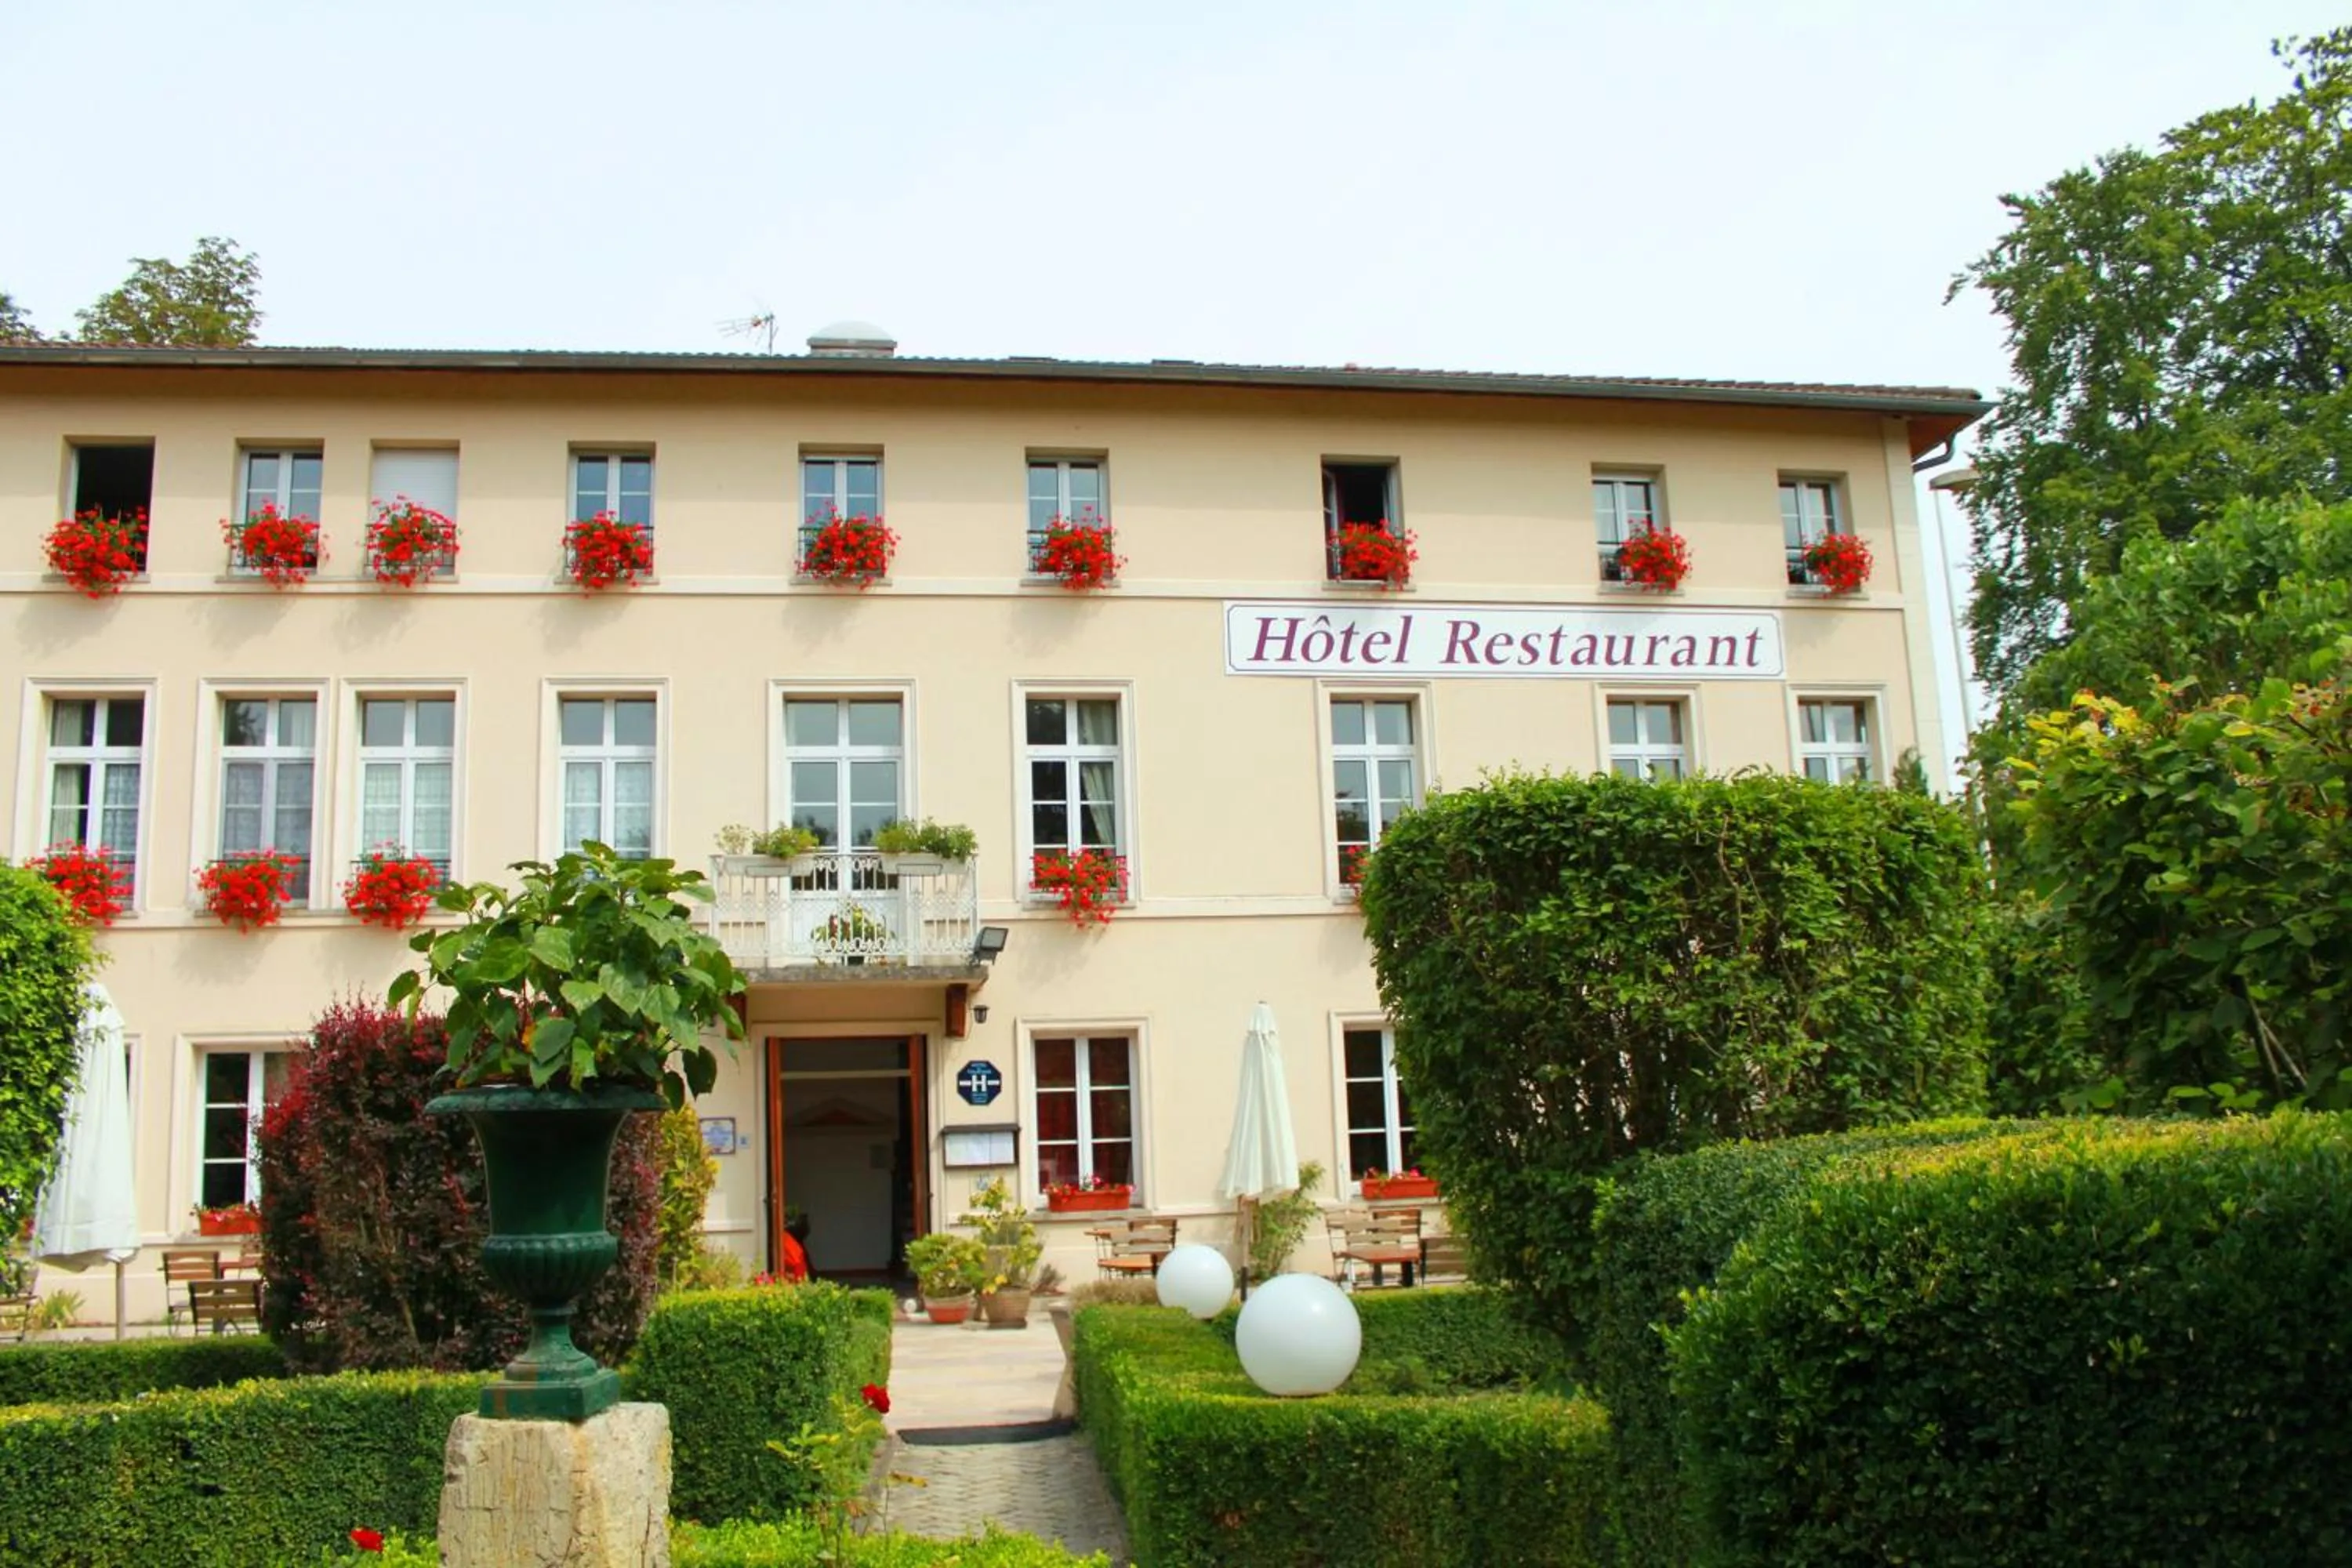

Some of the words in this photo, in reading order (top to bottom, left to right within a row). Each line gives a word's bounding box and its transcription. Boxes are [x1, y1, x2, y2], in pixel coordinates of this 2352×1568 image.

[1247, 615, 1414, 664] Hôtel
[1439, 619, 1765, 668] Restaurant
[971, 1074, 987, 1092] H
